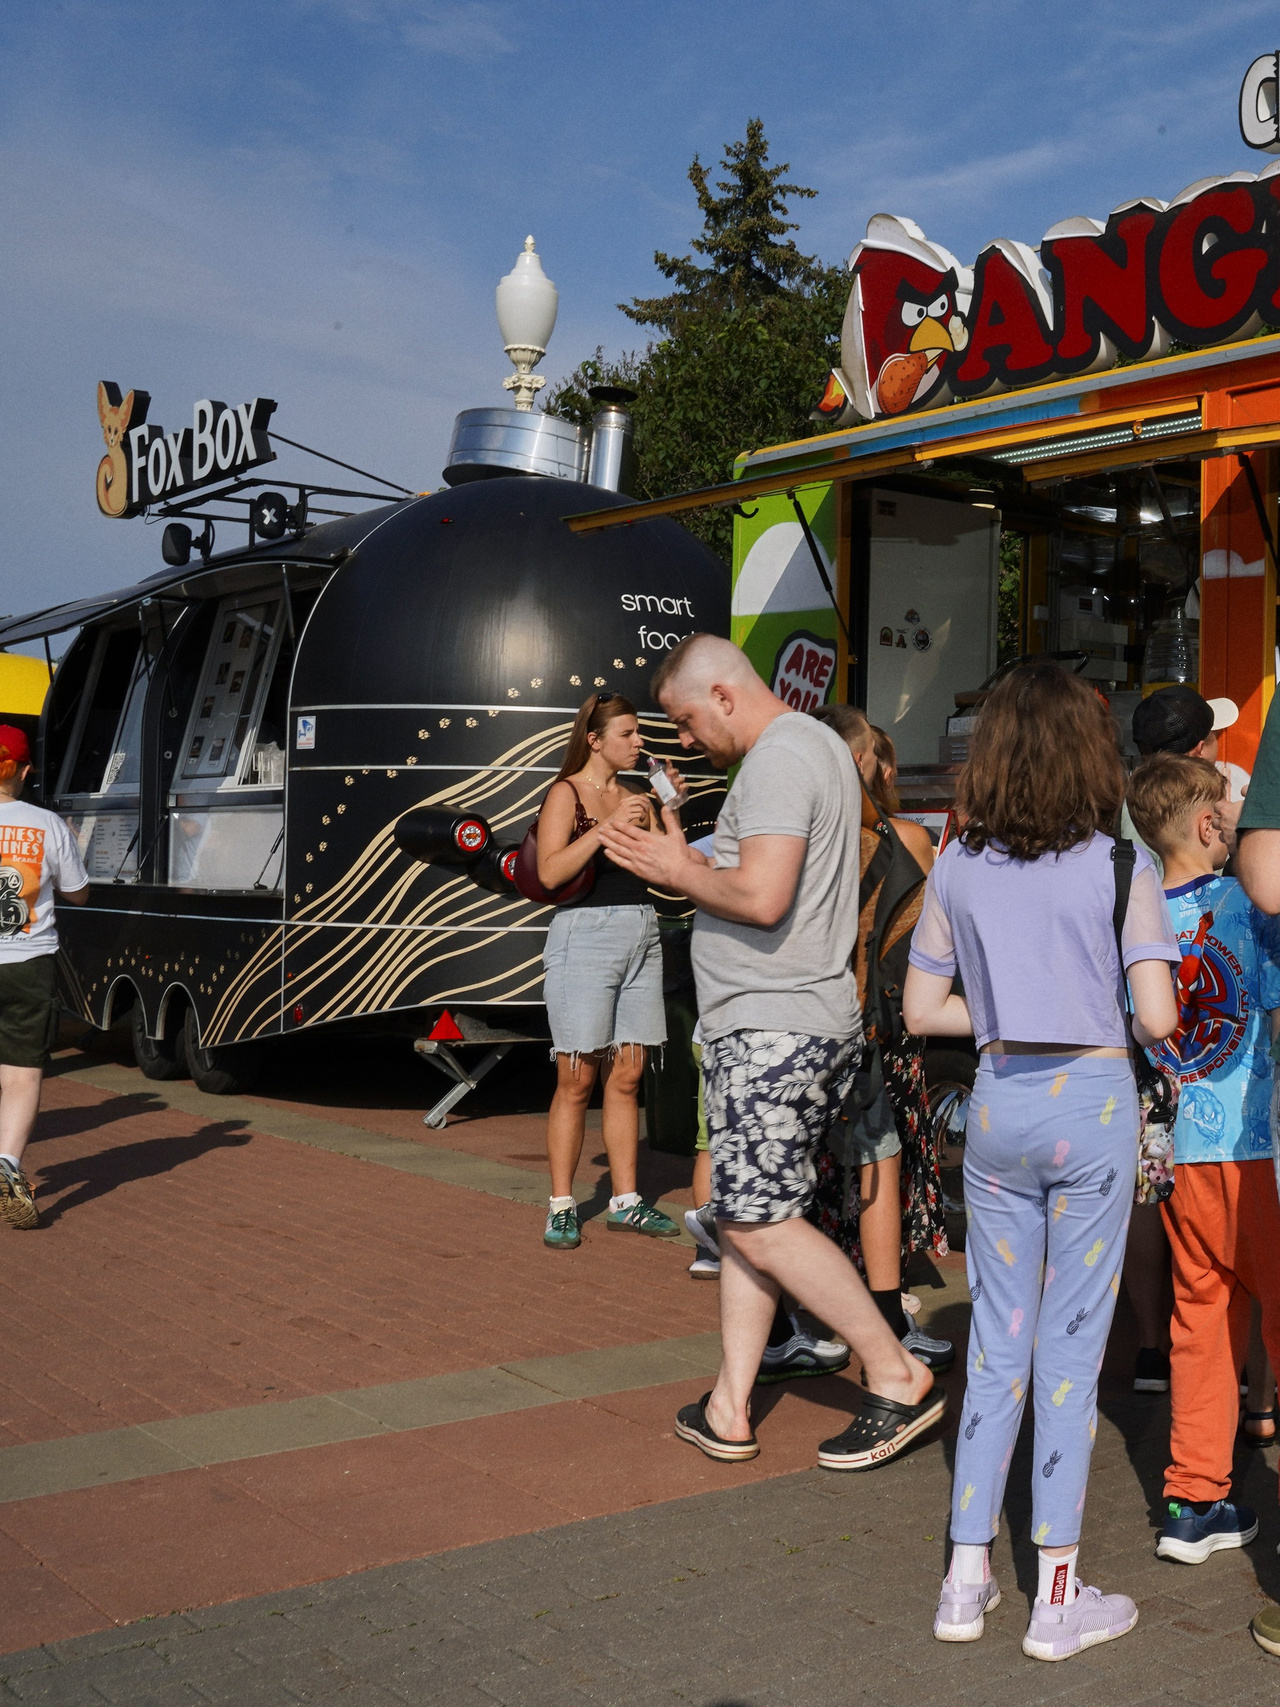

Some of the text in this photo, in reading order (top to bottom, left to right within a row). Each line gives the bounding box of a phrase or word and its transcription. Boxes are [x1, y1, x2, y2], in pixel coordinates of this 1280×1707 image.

[621, 593, 695, 618] smart
[638, 625, 695, 650] foo
[784, 642, 833, 689] ARE
[12, 854, 37, 863] Brand
[1180, 988, 1249, 1085] RESPONSIBILITY
